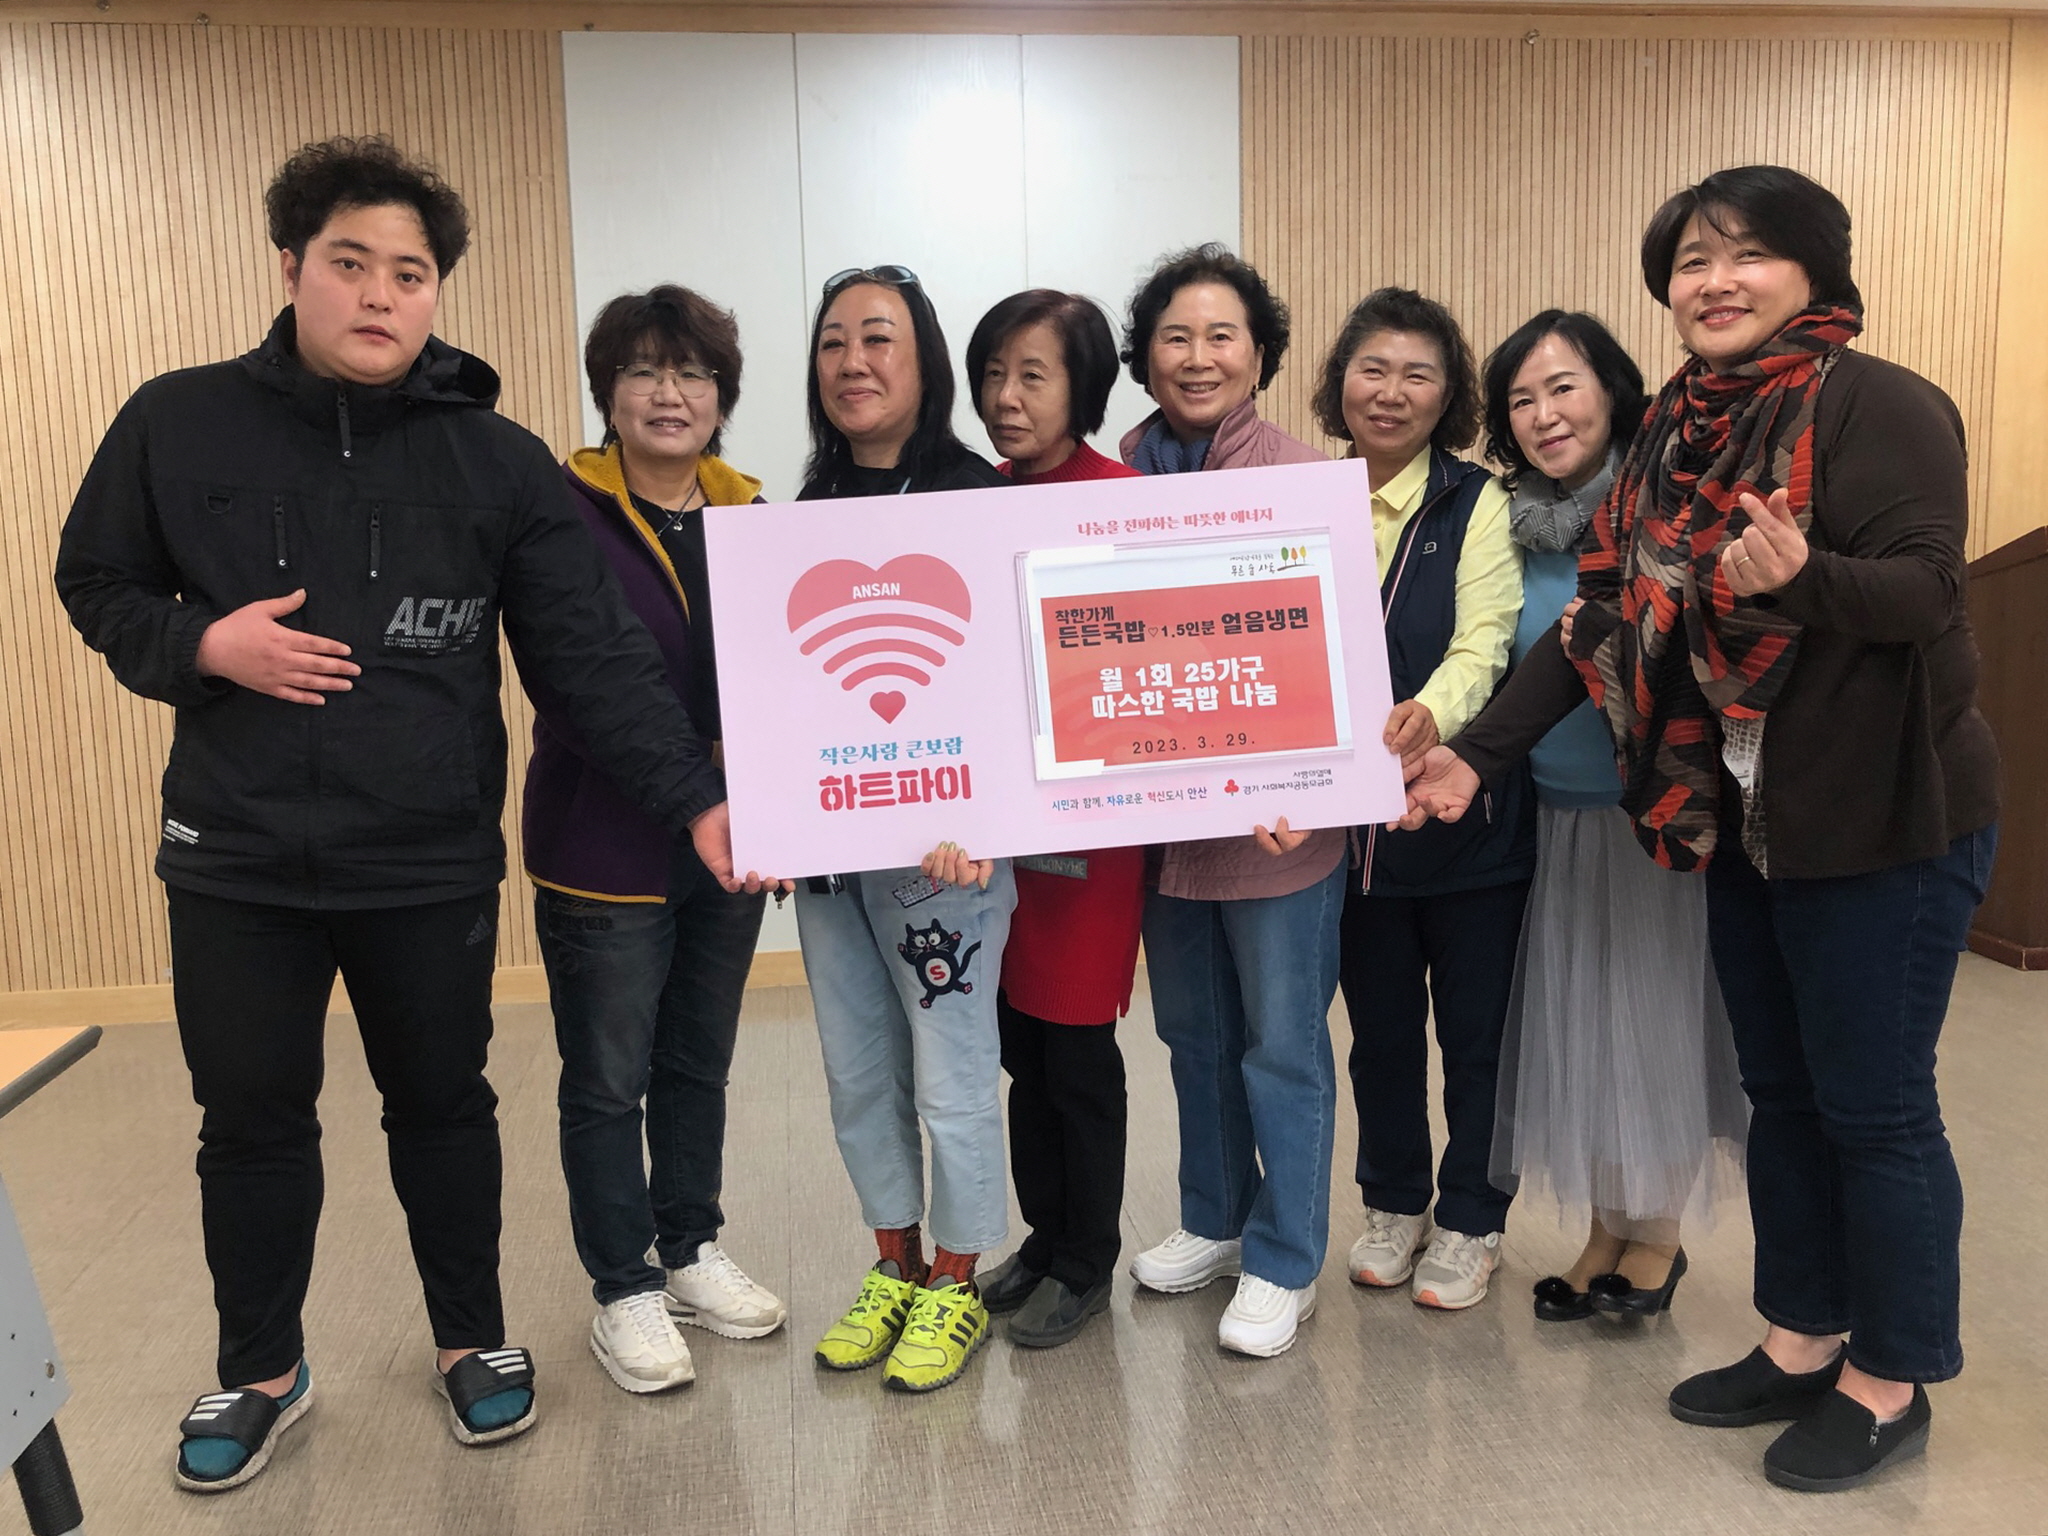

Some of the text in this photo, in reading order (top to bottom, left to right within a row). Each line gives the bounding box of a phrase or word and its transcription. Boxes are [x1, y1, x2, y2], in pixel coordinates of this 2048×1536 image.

[1077, 520, 1120, 536] 나눔을
[1123, 516, 1180, 533] 전파하는
[1183, 511, 1226, 528] 따뜻한
[853, 583, 900, 599] ANSAN
[1055, 606, 1114, 624] 착한가게
[1221, 607, 1309, 635] 얼음냉면
[1100, 656, 1265, 693] 월 1회 25가구
[1092, 682, 1278, 719] 따스한 국밥 나눔
[819, 736, 964, 766] 작은사랑 큰보람
[1133, 738, 1186, 754] 2023.
[1226, 732, 1255, 747] 29.
[819, 764, 972, 811] 하트파이
[1052, 786, 1208, 811] 시민과 함께, 자유로운 혁신도시 안산
[1243, 785, 1260, 796] 경기
[929, 965, 947, 981] S
